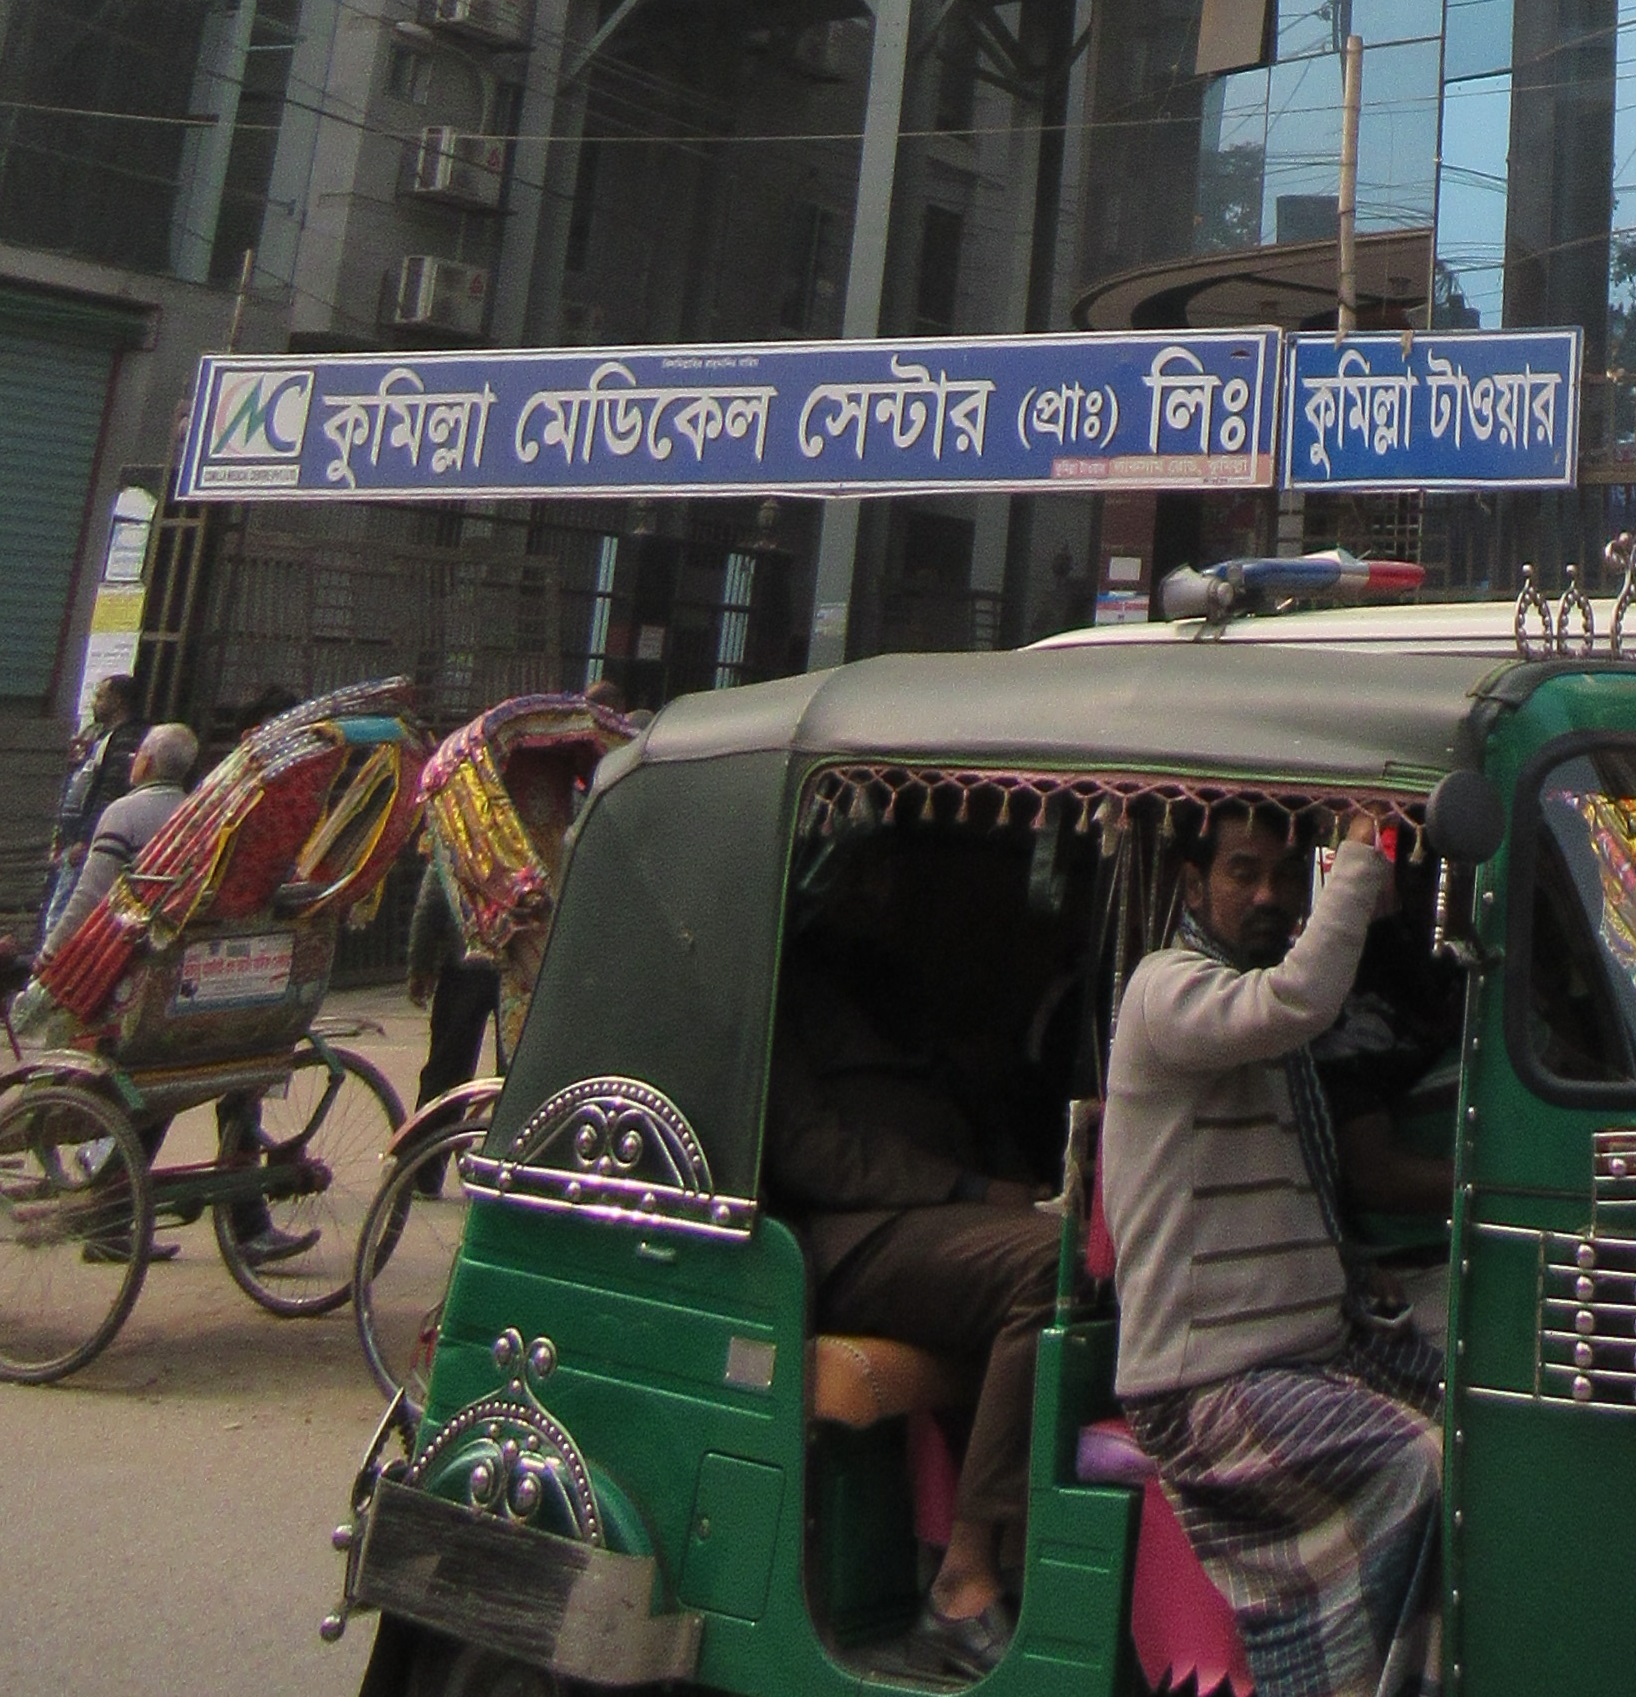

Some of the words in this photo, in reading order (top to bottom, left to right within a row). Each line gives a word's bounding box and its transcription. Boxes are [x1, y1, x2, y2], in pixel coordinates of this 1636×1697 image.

[321, 367, 497, 489] কুমিল্লা
[514, 361, 778, 465] মেডিকেল
[799, 352, 997, 461] সেন্টার
[1017, 381, 1119, 450] (প্রাঃ)
[1142, 346, 1251, 456] লিঃ
[1301, 348, 1419, 479] কুমিল্লা
[1425, 349, 1563, 451] টাওয়ার
